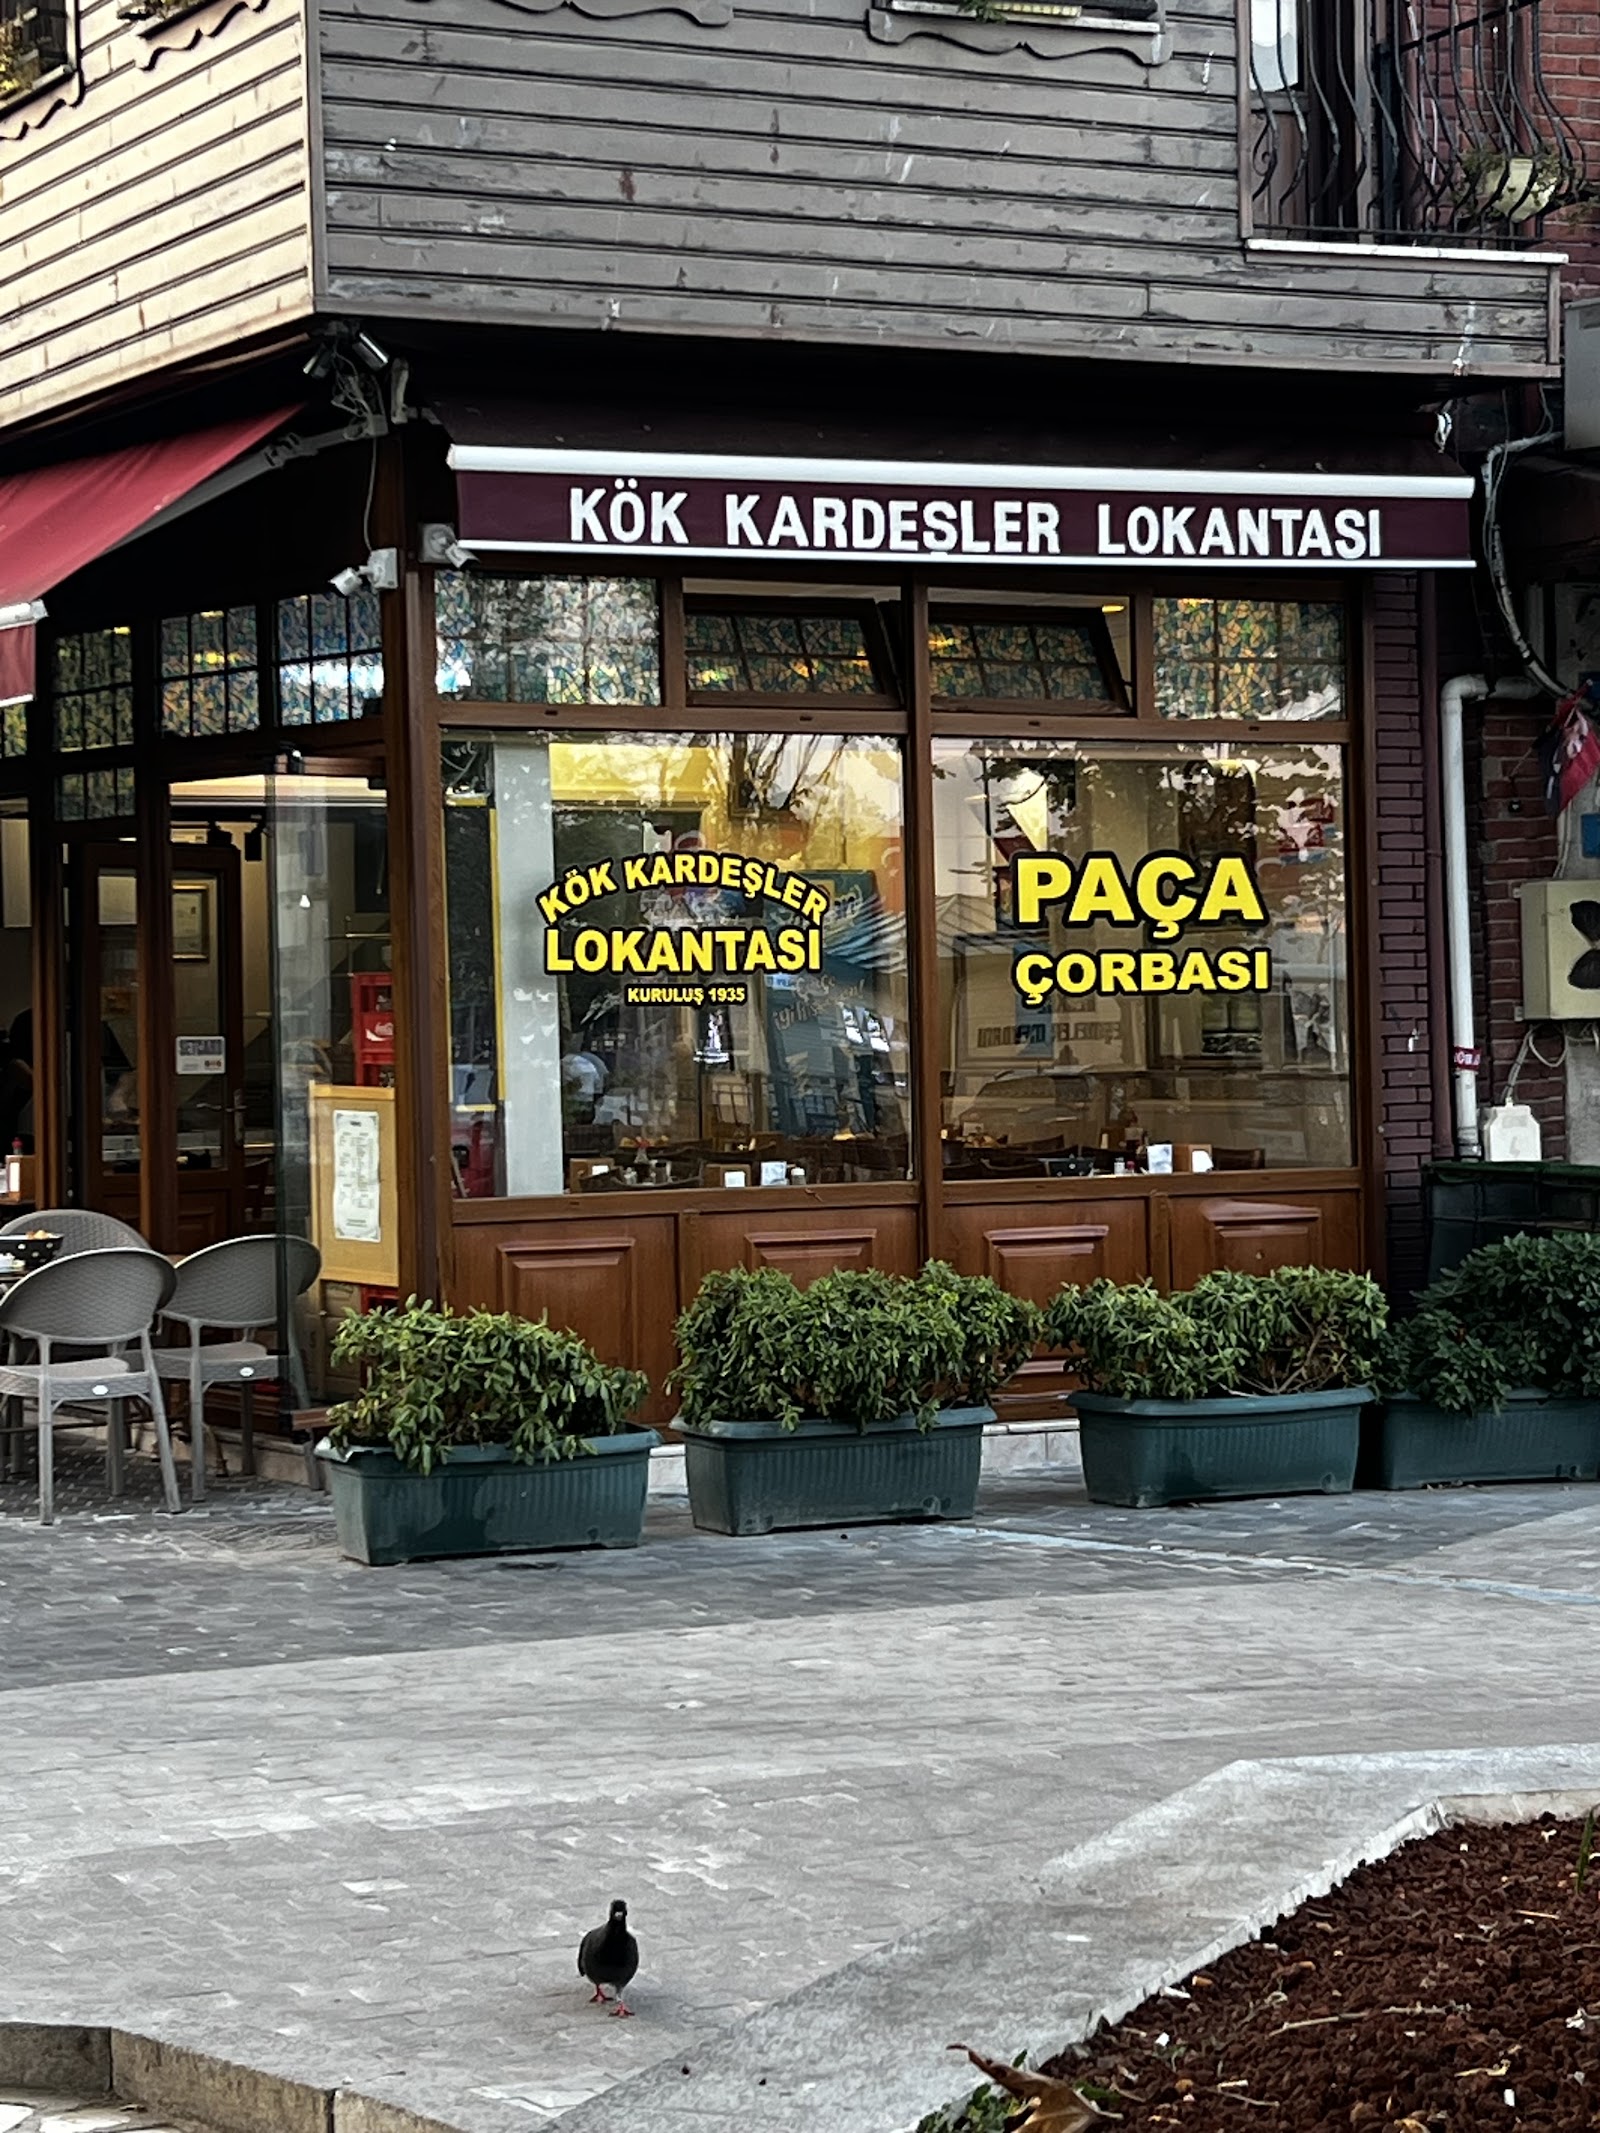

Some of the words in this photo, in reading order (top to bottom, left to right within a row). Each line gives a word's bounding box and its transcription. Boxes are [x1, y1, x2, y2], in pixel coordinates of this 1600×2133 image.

[569, 478, 689, 544] KÖK
[1097, 503, 1381, 559] LOKANTASI
[539, 861, 617, 924] KÖK
[624, 853, 828, 926] KARDEŞLER
[1017, 856, 1265, 939] PAÇA
[546, 929, 821, 972] LOKANTASI
[1016, 951, 1269, 1005] ÇORBASI
[627, 987, 704, 1005] KURULUŞ
[710, 987, 746, 1002] 1935
